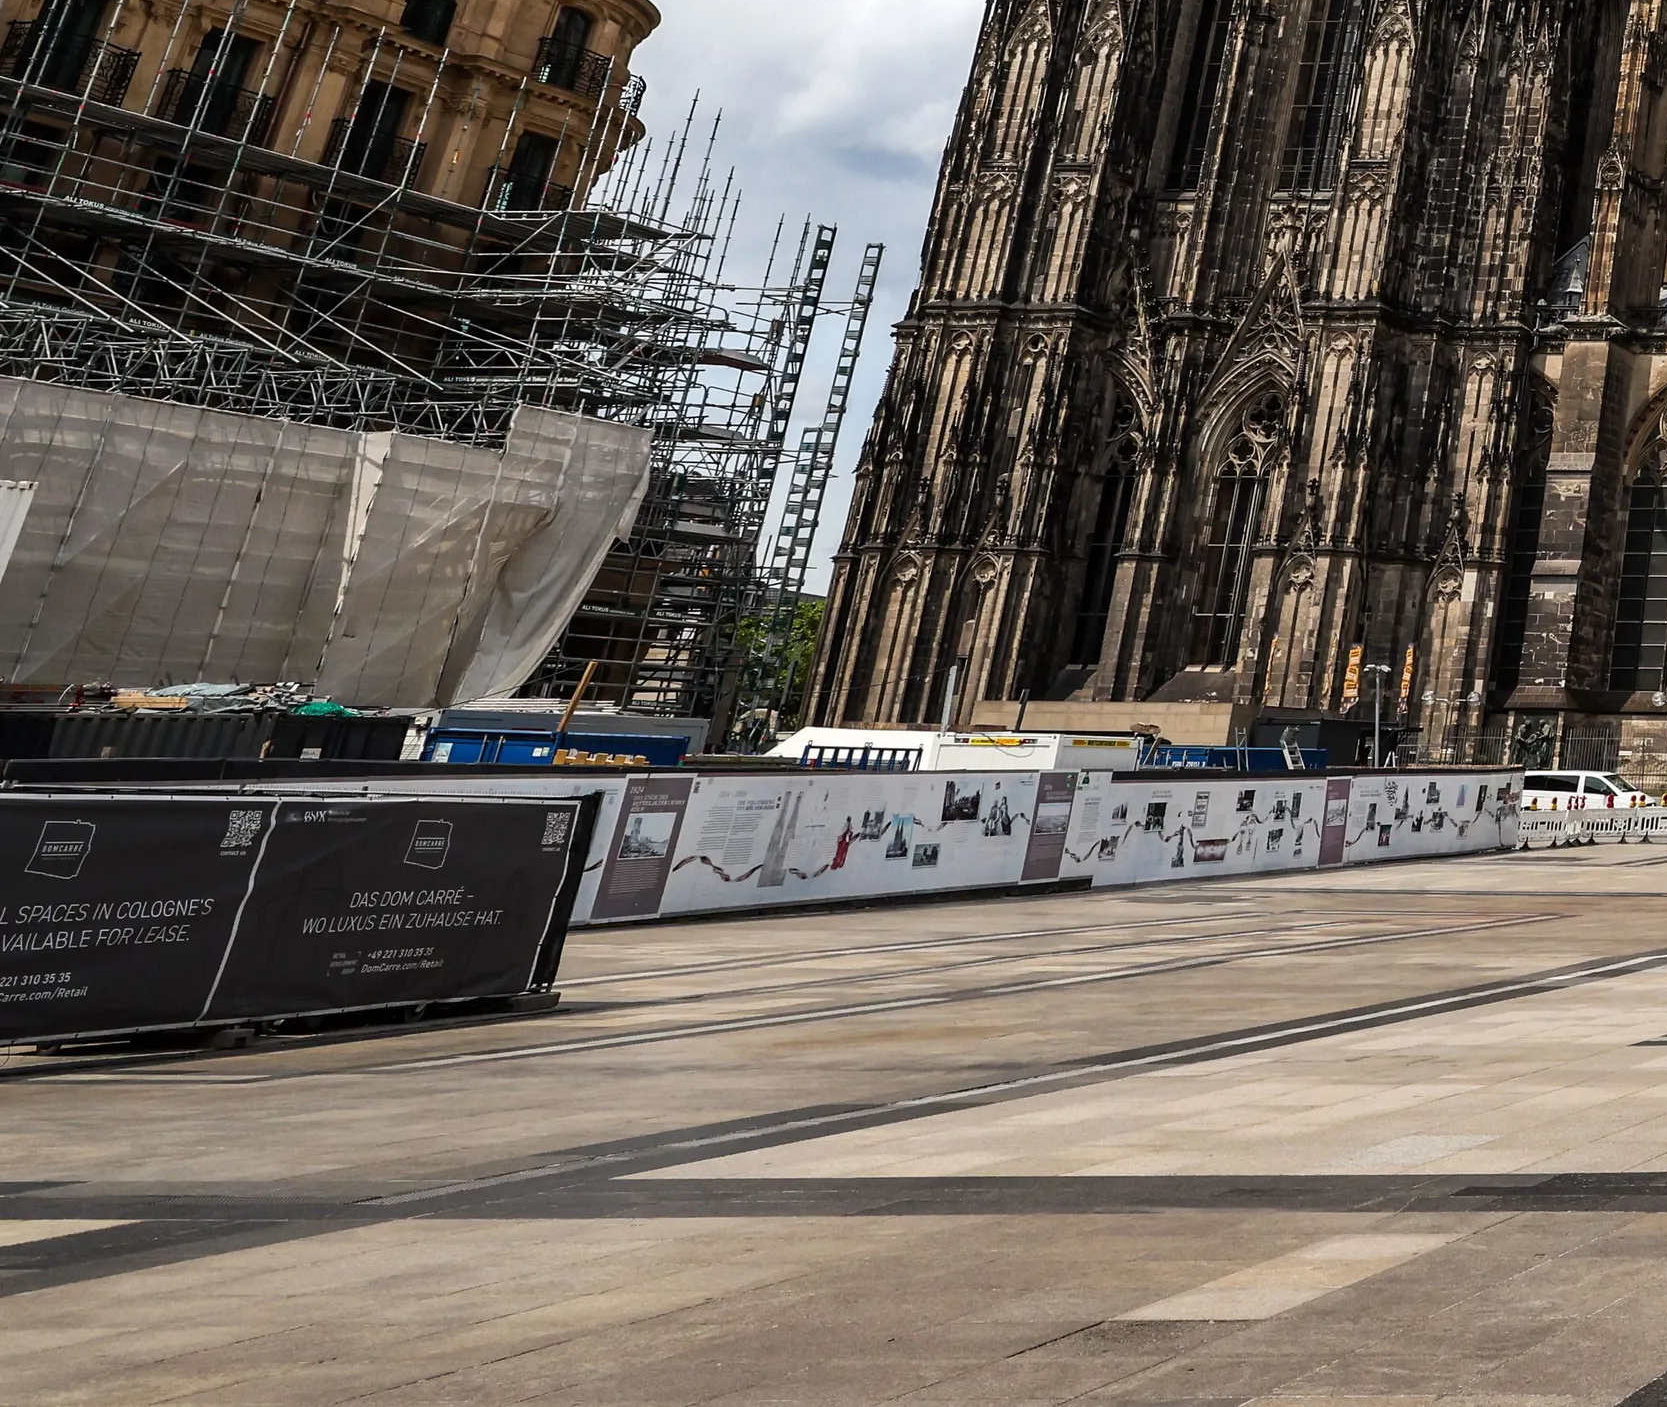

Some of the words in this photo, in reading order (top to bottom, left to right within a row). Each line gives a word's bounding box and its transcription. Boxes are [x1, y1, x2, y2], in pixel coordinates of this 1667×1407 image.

[63, 195, 78, 203] ALI
[79, 199, 105, 209] TOKUS
[336, 260, 357, 270] TOKUS
[350, 891, 378, 909] DAS
[380, 890, 414, 907] DOM
[416, 886, 464, 906] CARRÉ
[15, 903, 90, 924] SPACES
[92, 902, 114, 920] IN
[116, 898, 214, 920] COLOGNE'S
[302, 917, 327, 935] WO
[328, 914, 377, 933] LUXUS
[378, 913, 403, 930] EIN
[405, 910, 475, 929] ZUHAUSE
[475, 909, 503, 926] HAT.
[96, 928, 133, 946] FOR
[134, 925, 190, 944] LEASE.
[368, 950, 381, 959] +49
[382, 949, 397, 959] 221
[398, 948, 414, 958] 310
[414, 947, 424, 957] 35
[360, 959, 444, 973] DomCarre.com/Retail
[0, 976, 18, 987] 221
[20, 974, 41, 986] 310
[42, 973, 56, 984] 35
[57, 972, 72, 983] 35
